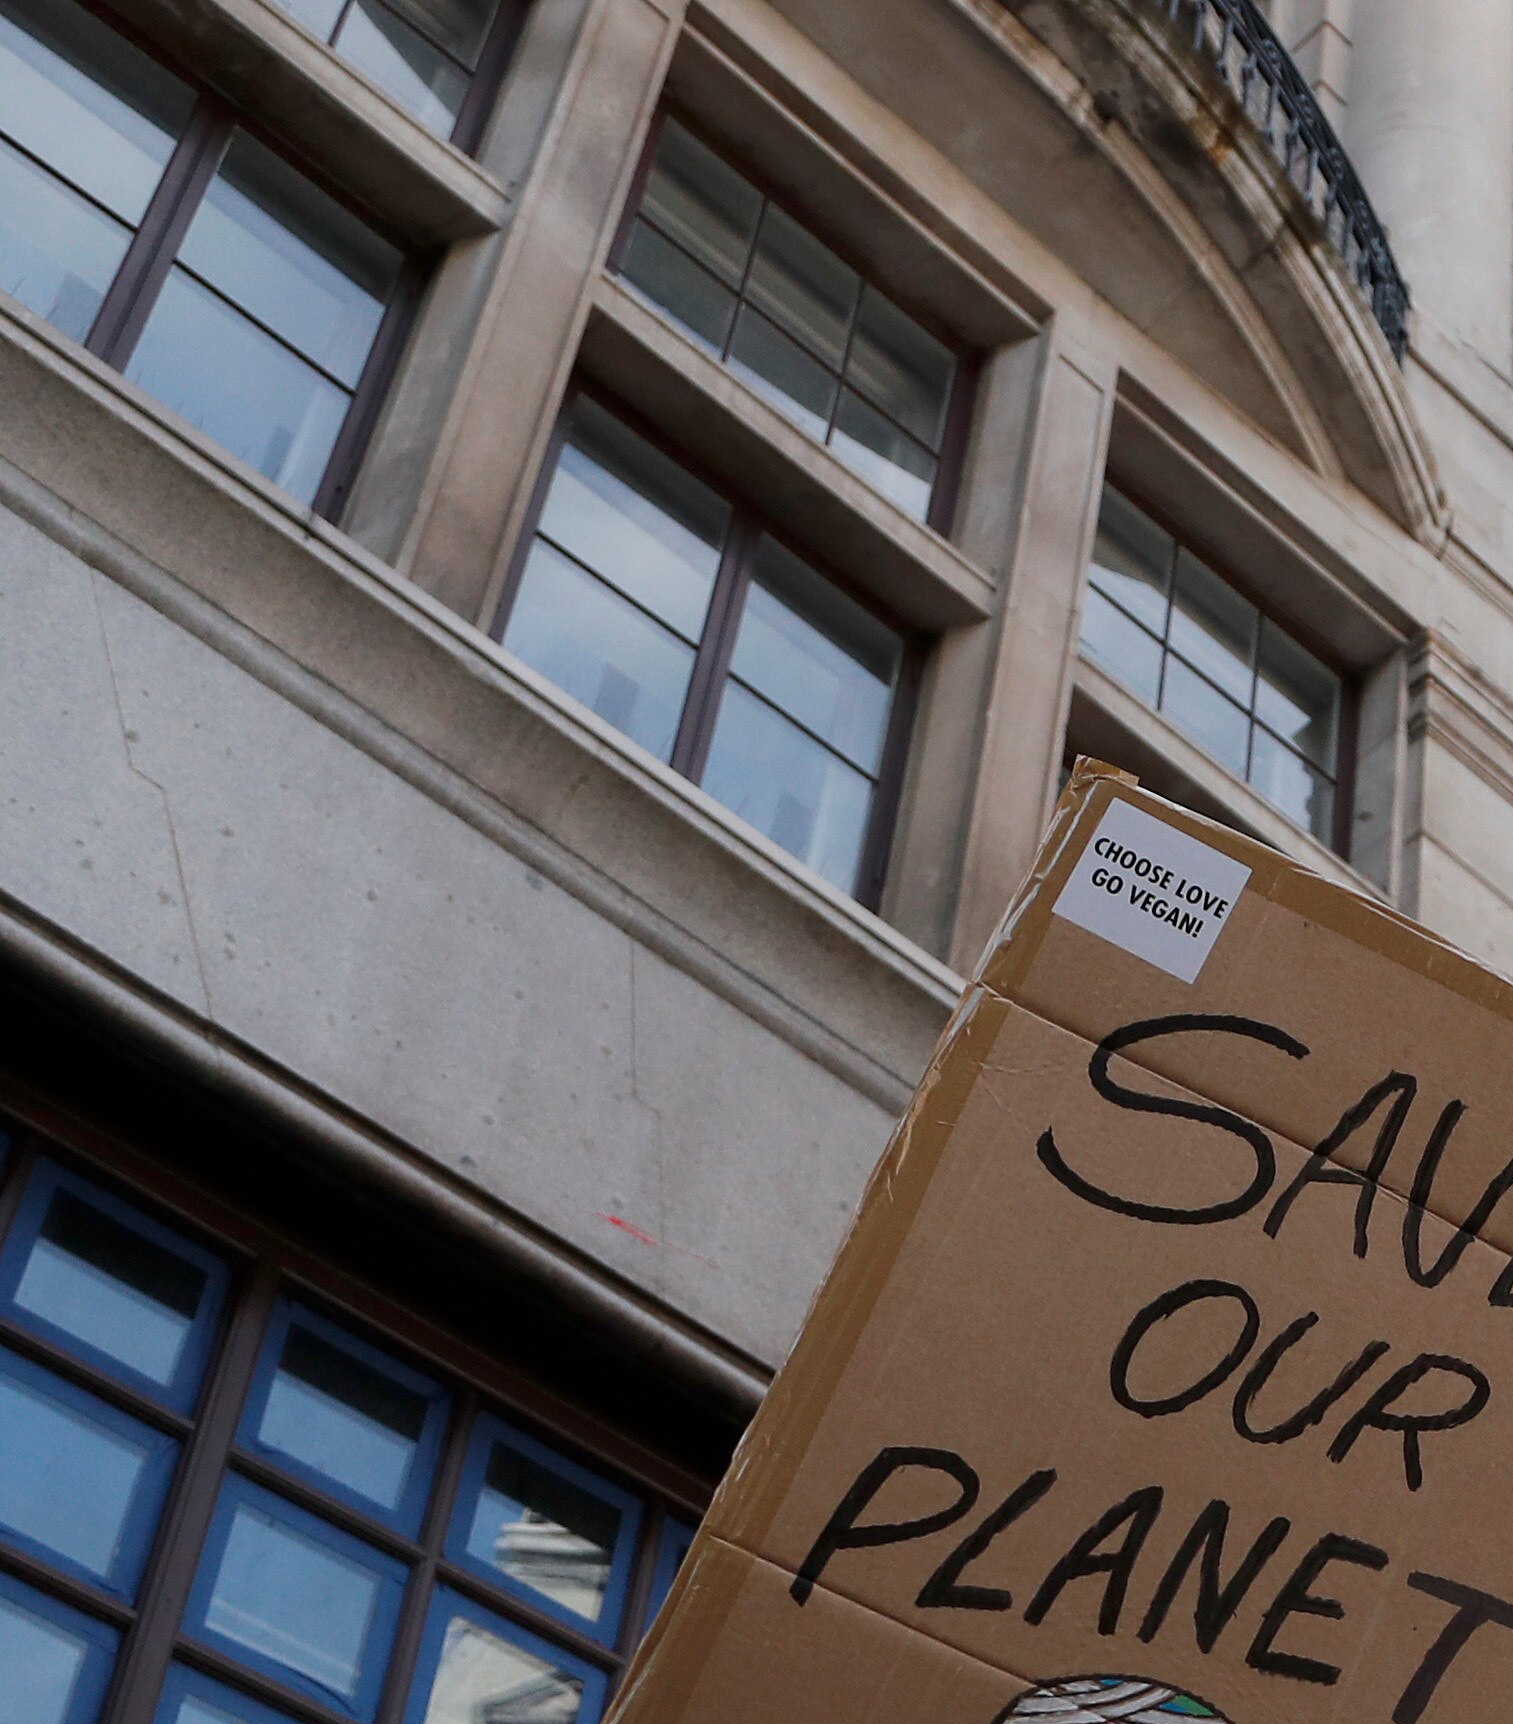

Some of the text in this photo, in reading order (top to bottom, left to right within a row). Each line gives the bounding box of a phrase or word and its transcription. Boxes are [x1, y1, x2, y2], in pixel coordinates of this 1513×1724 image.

[1091, 868, 1204, 938] GO VEGAN!
[1094, 838, 1229, 919] CHOOSE LOVE
[1110, 1279, 1492, 1492] OUR
